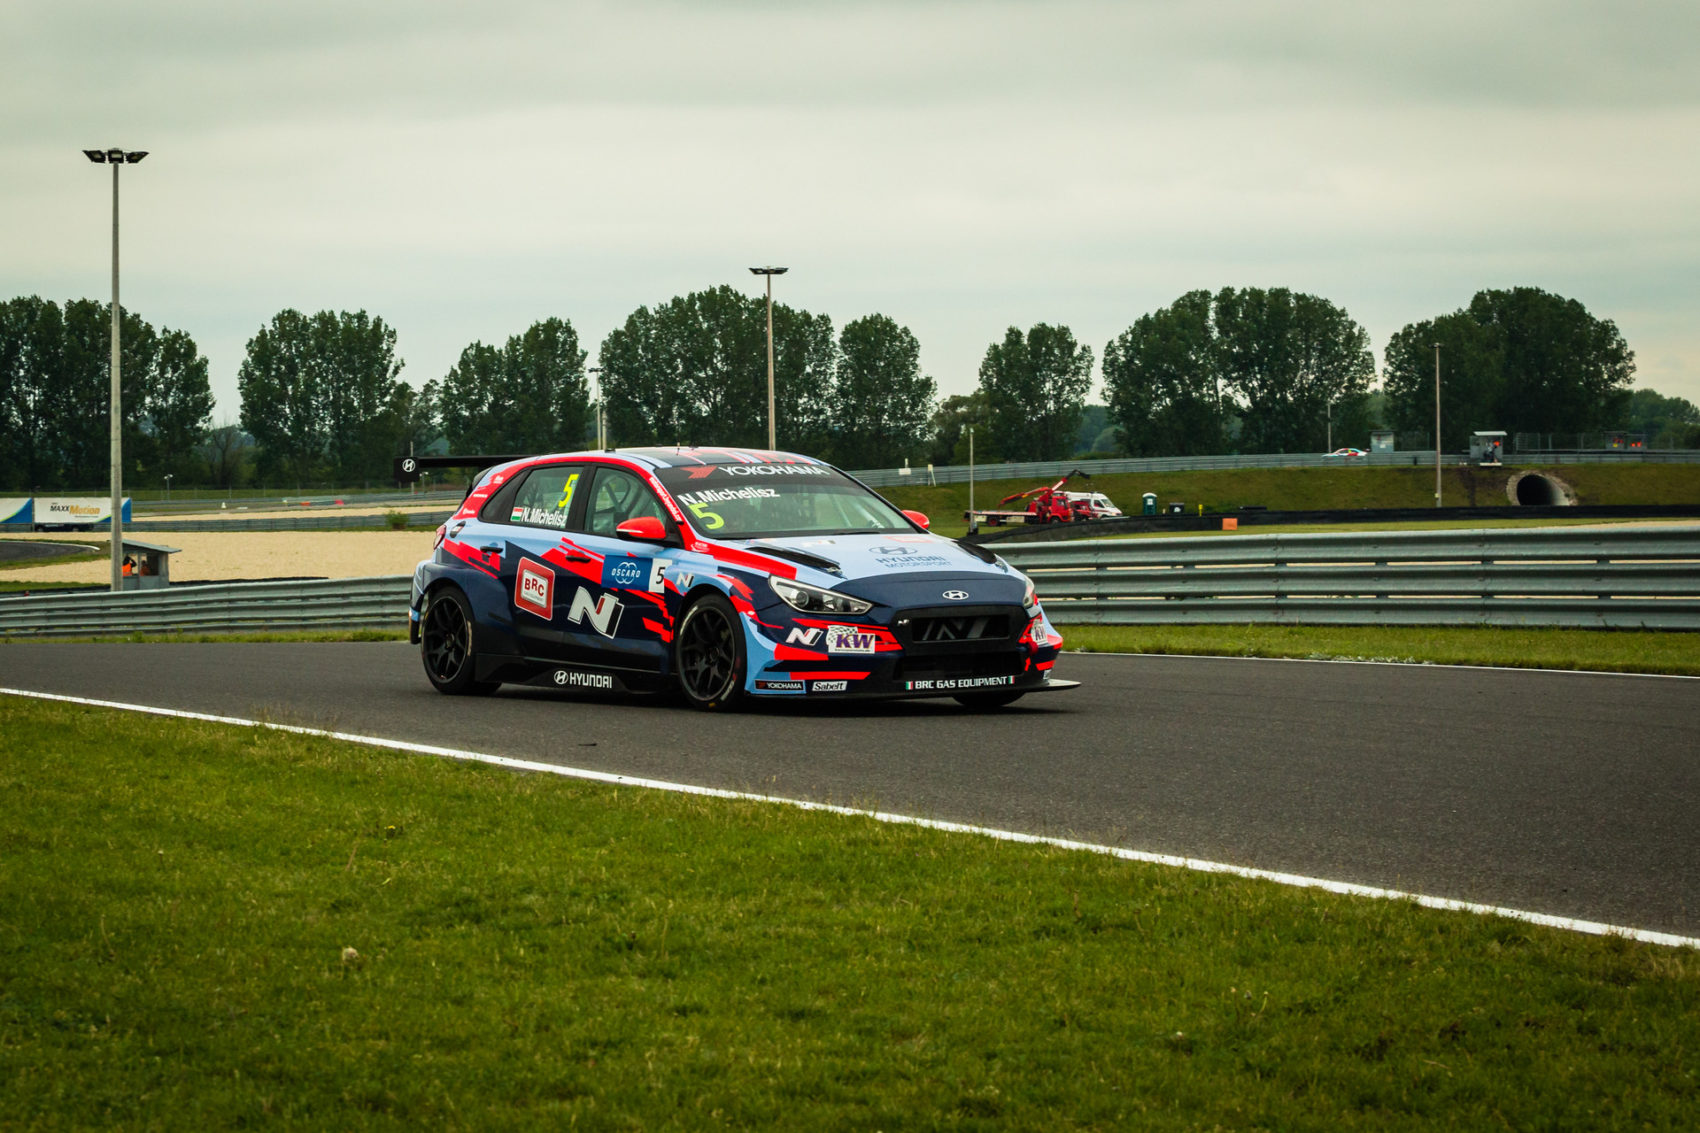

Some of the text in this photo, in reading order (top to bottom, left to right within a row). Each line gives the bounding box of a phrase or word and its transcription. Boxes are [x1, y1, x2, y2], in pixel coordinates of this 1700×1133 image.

[718, 466, 830, 476] YOKOHAMA
[558, 473, 579, 508] 5
[677, 487, 780, 506] N.Michelisz
[69, 504, 100, 515] Motion
[521, 506, 567, 526] N.Michelisz
[688, 502, 725, 530] 5
[611, 568, 641, 578] OSCARO
[656, 566, 666, 584] 5
[524, 577, 545, 597] BRC
[835, 633, 874, 649] KW
[569, 672, 613, 689] HYUNDAI
[814, 682, 844, 690] Sabelt
[915, 676, 1007, 689] BRC GAS EQUIPMENT
